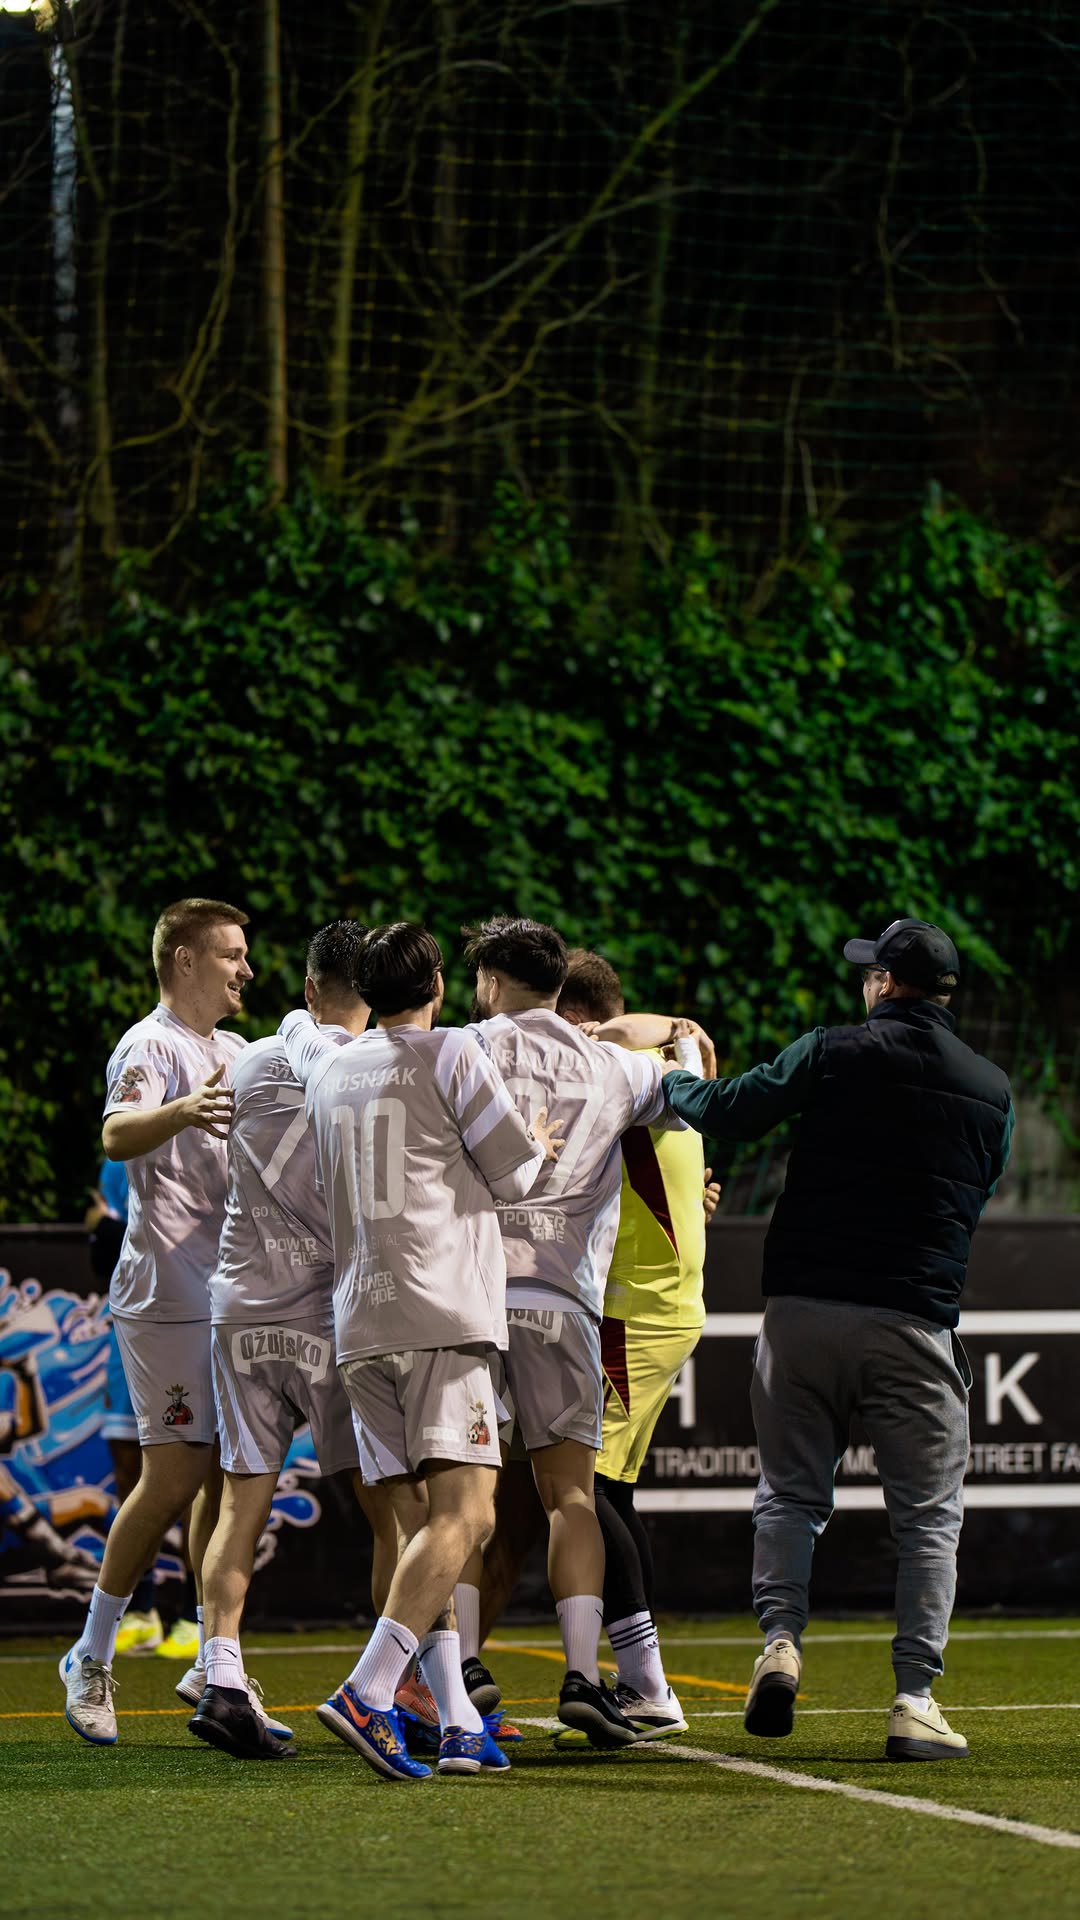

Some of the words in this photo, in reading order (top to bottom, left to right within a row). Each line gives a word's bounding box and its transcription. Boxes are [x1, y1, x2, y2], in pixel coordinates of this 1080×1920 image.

[331, 1097, 407, 1227] 10
[251, 1206, 269, 1218] GO
[240, 1329, 322, 1367] Ožujsko
[985, 1352, 1043, 1425] K
[653, 1446, 760, 1477] TRADITIO
